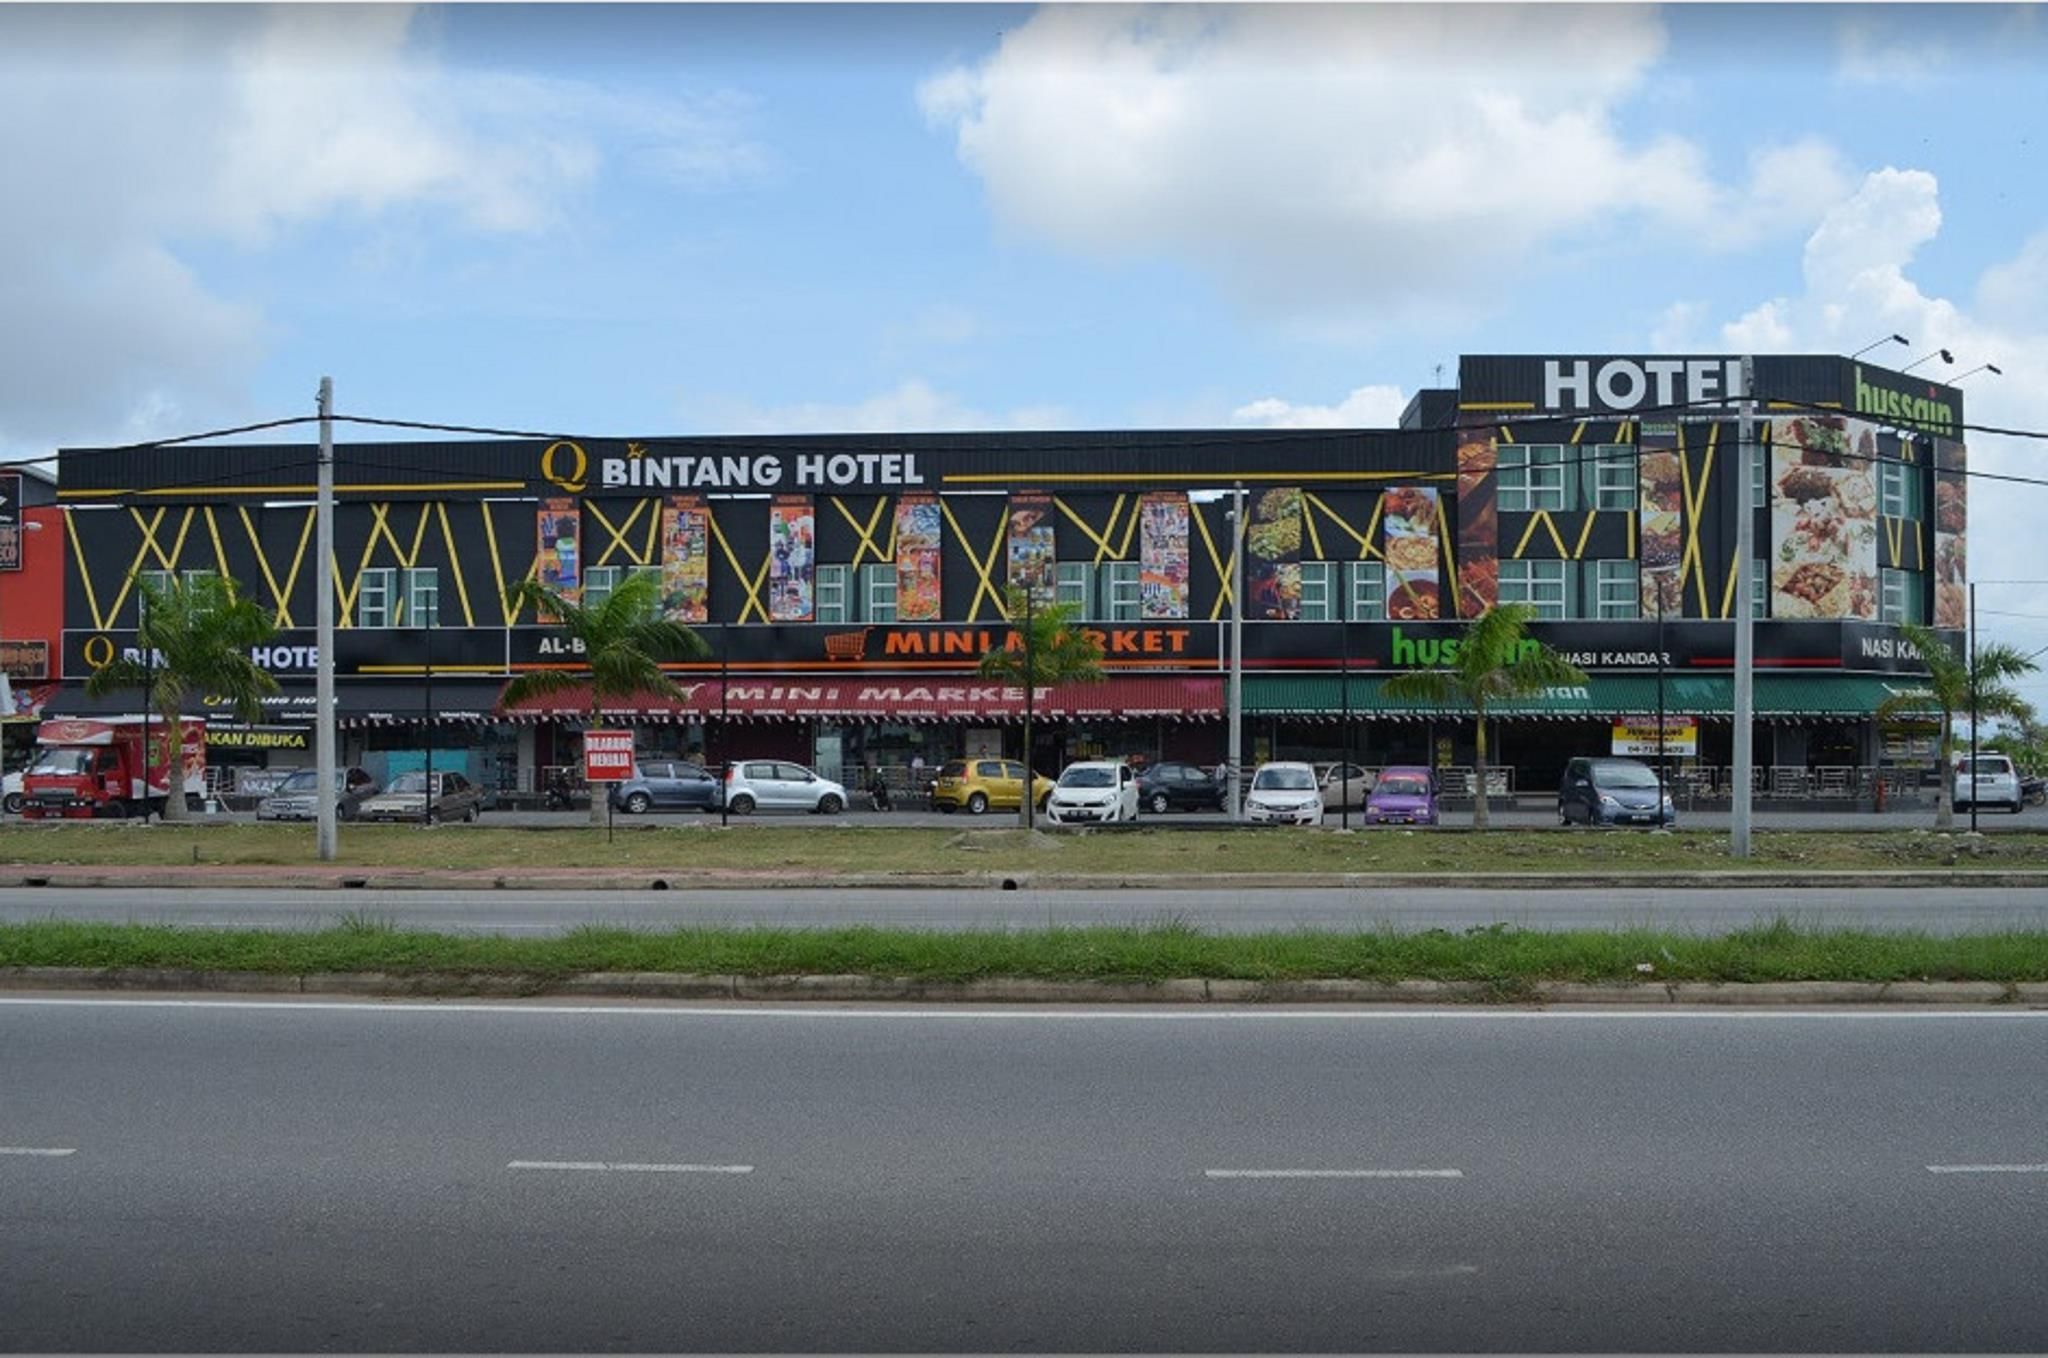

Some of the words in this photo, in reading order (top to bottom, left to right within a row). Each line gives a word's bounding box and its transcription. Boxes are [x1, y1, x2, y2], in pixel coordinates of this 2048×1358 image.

[1545, 359, 1758, 409] HOTEL
[1854, 365, 1952, 435] hussain
[541, 441, 587, 492] Q
[602, 452, 783, 488] BINTANG
[797, 453, 923, 486] HOTEL
[885, 631, 989, 654] MINI
[1861, 637, 1894, 659] NASI
[252, 646, 335, 669] HOTE
[1601, 651, 1671, 666] KANDAR
[726, 687, 839, 701] MINI
[859, 686, 1055, 702] MARKET
[245, 733, 306, 748] DIBUKA
